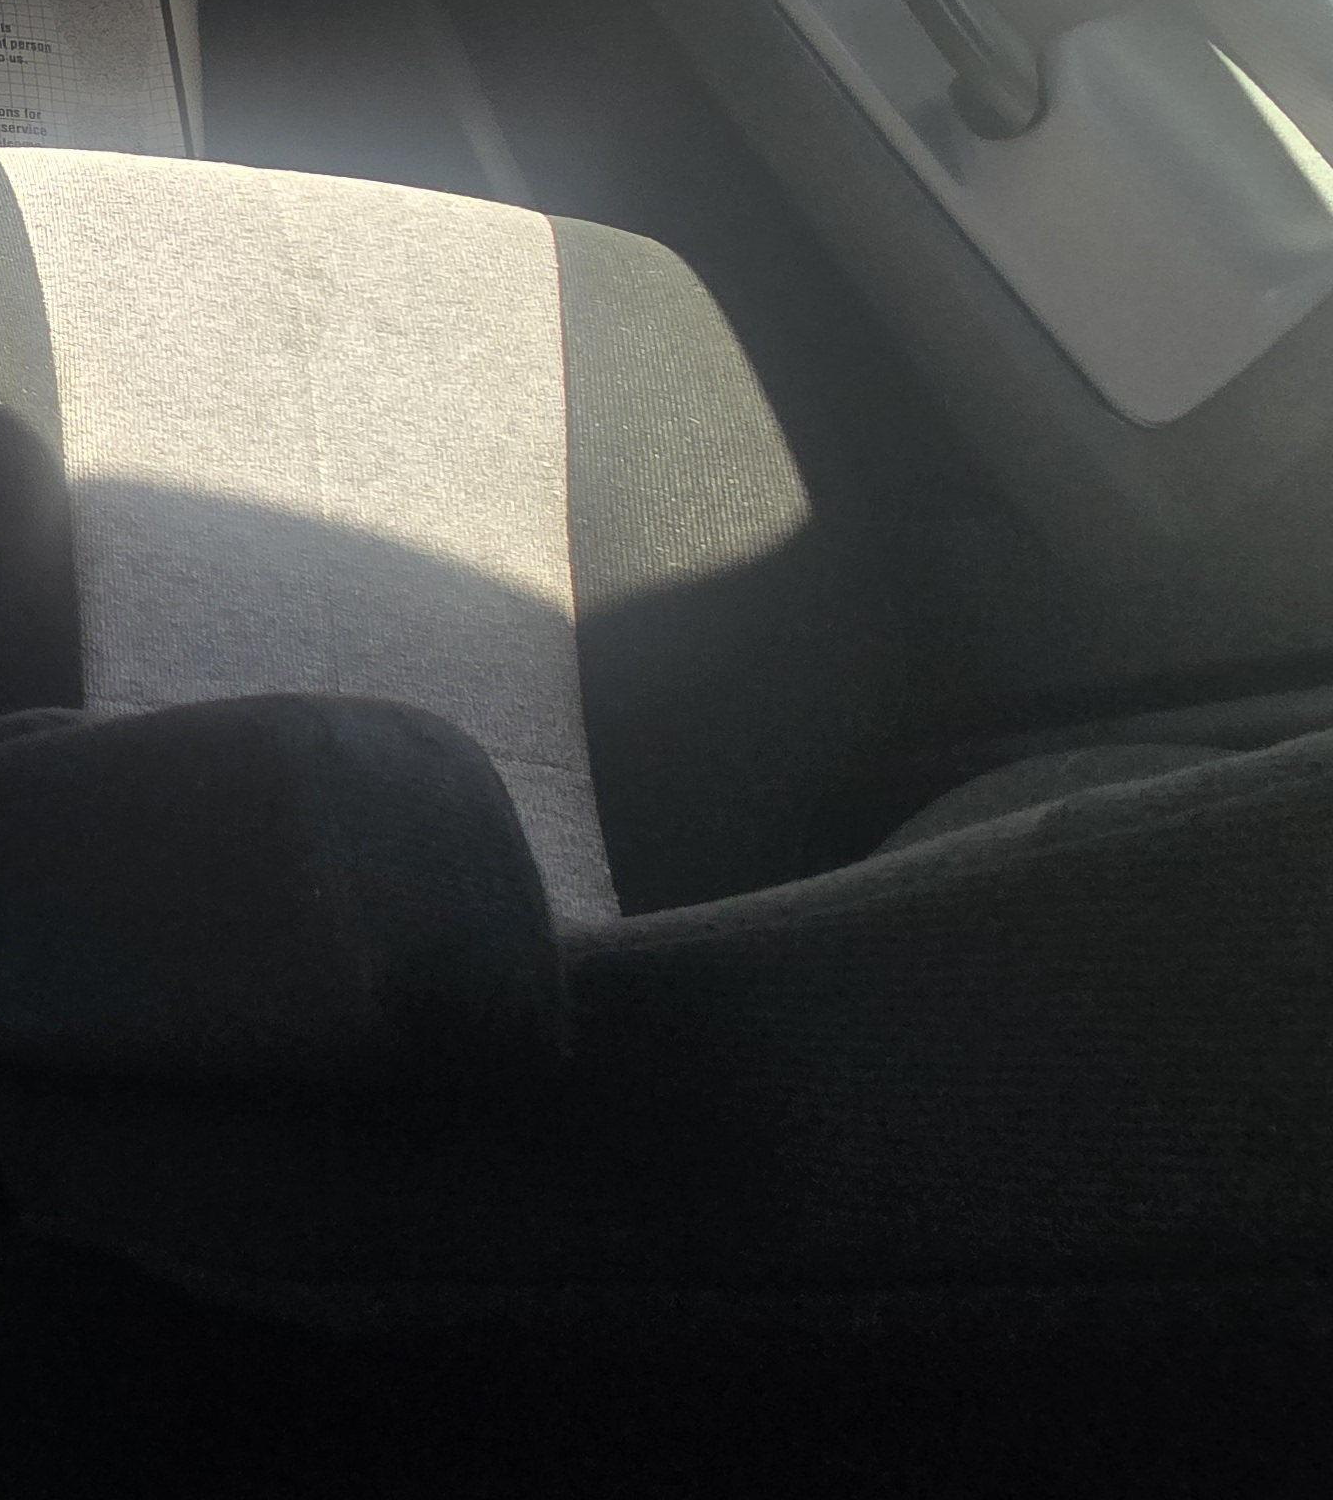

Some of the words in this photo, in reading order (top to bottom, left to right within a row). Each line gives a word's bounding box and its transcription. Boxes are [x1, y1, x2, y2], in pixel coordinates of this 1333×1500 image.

[1, 23, 12, 33] is
[10, 39, 52, 53] person
[24, 108, 41, 119] for
[1, 123, 48, 136] service
